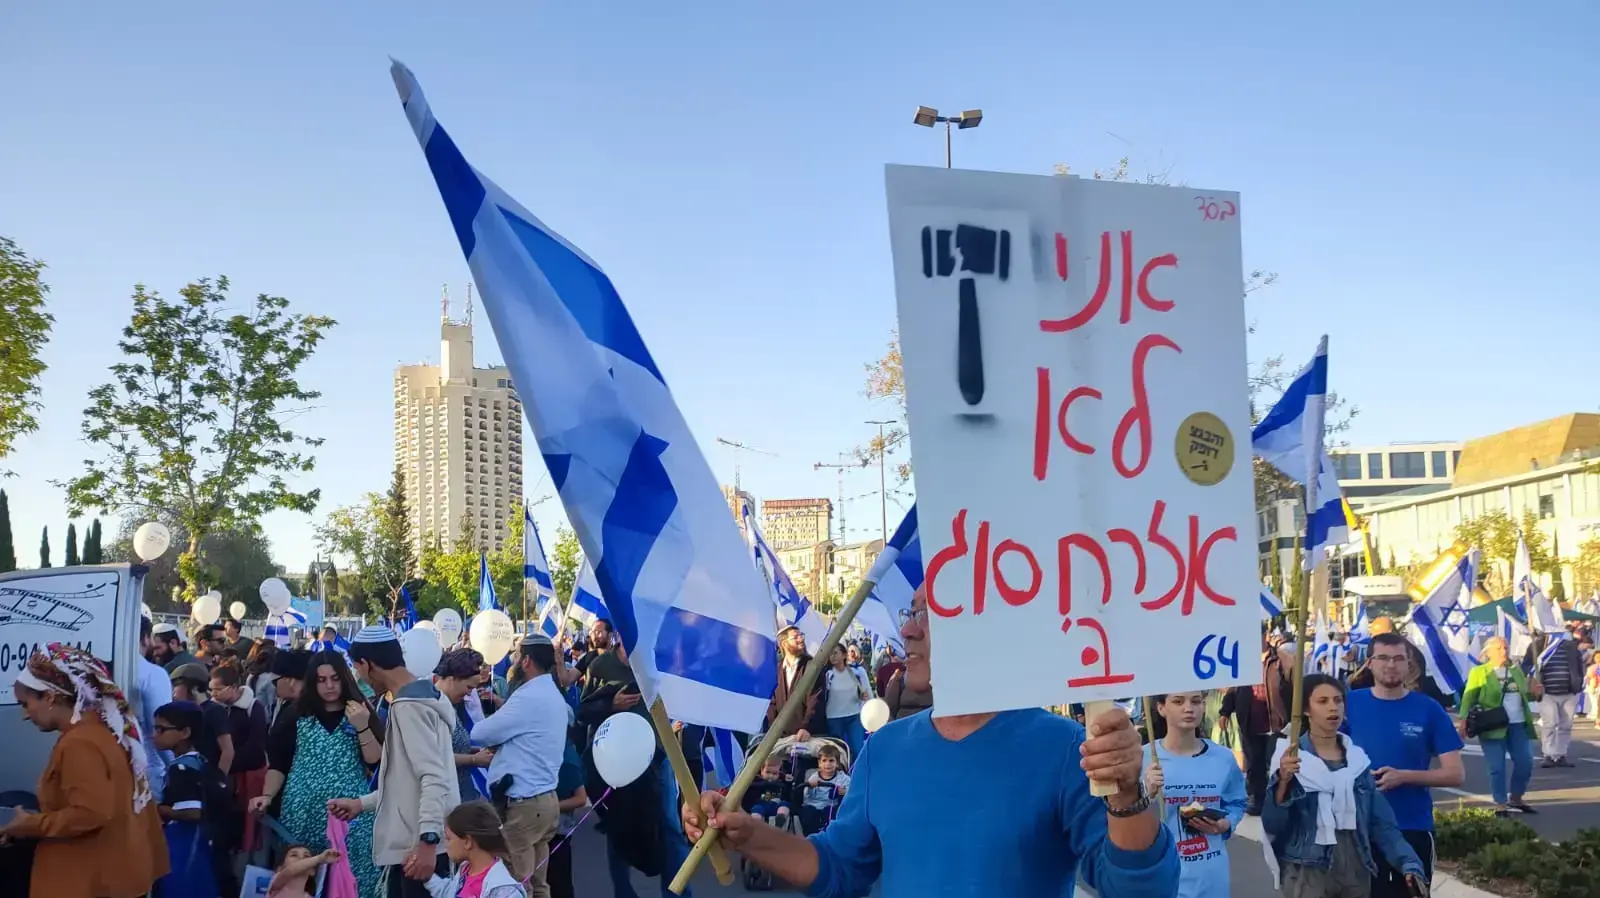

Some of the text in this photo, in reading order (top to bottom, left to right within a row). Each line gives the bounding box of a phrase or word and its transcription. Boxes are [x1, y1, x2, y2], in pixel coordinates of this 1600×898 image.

[1040, 230, 1178, 332] אני
[1033, 334, 1182, 480] לא
[926, 500, 1237, 617] אזרח סוג
[1193, 634, 1239, 680] 64
